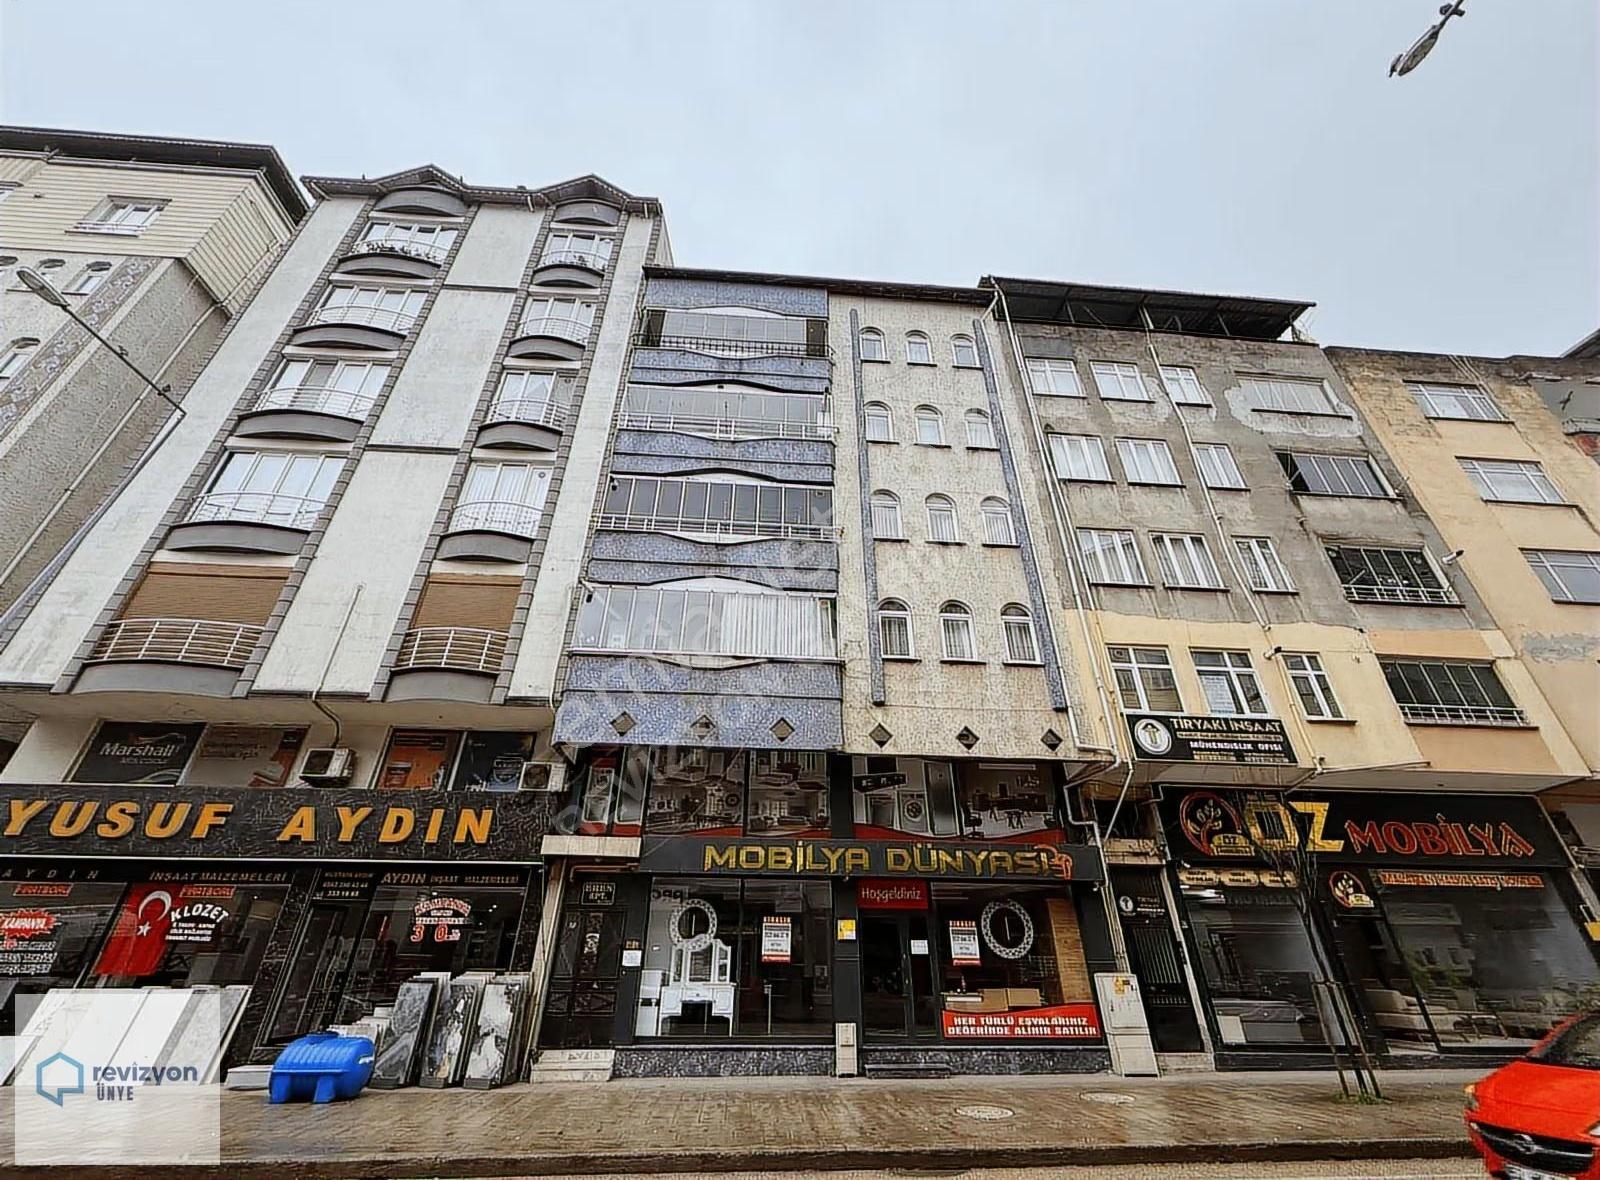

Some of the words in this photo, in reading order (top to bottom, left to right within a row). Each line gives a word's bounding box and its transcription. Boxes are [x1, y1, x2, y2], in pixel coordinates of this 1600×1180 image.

[100, 742, 174, 757] Marshall
[4, 799, 234, 839] YUSUF
[276, 806, 494, 844] AYDIN
[1344, 812, 1536, 858] MOBİLYA
[703, 840, 871, 874] MOBİLYA
[381, 872, 426, 884] AYDIN
[861, 886, 921, 903] Hoşgeldiniz
[170, 903, 229, 923] KLOZET
[953, 1015, 976, 1025] HER
